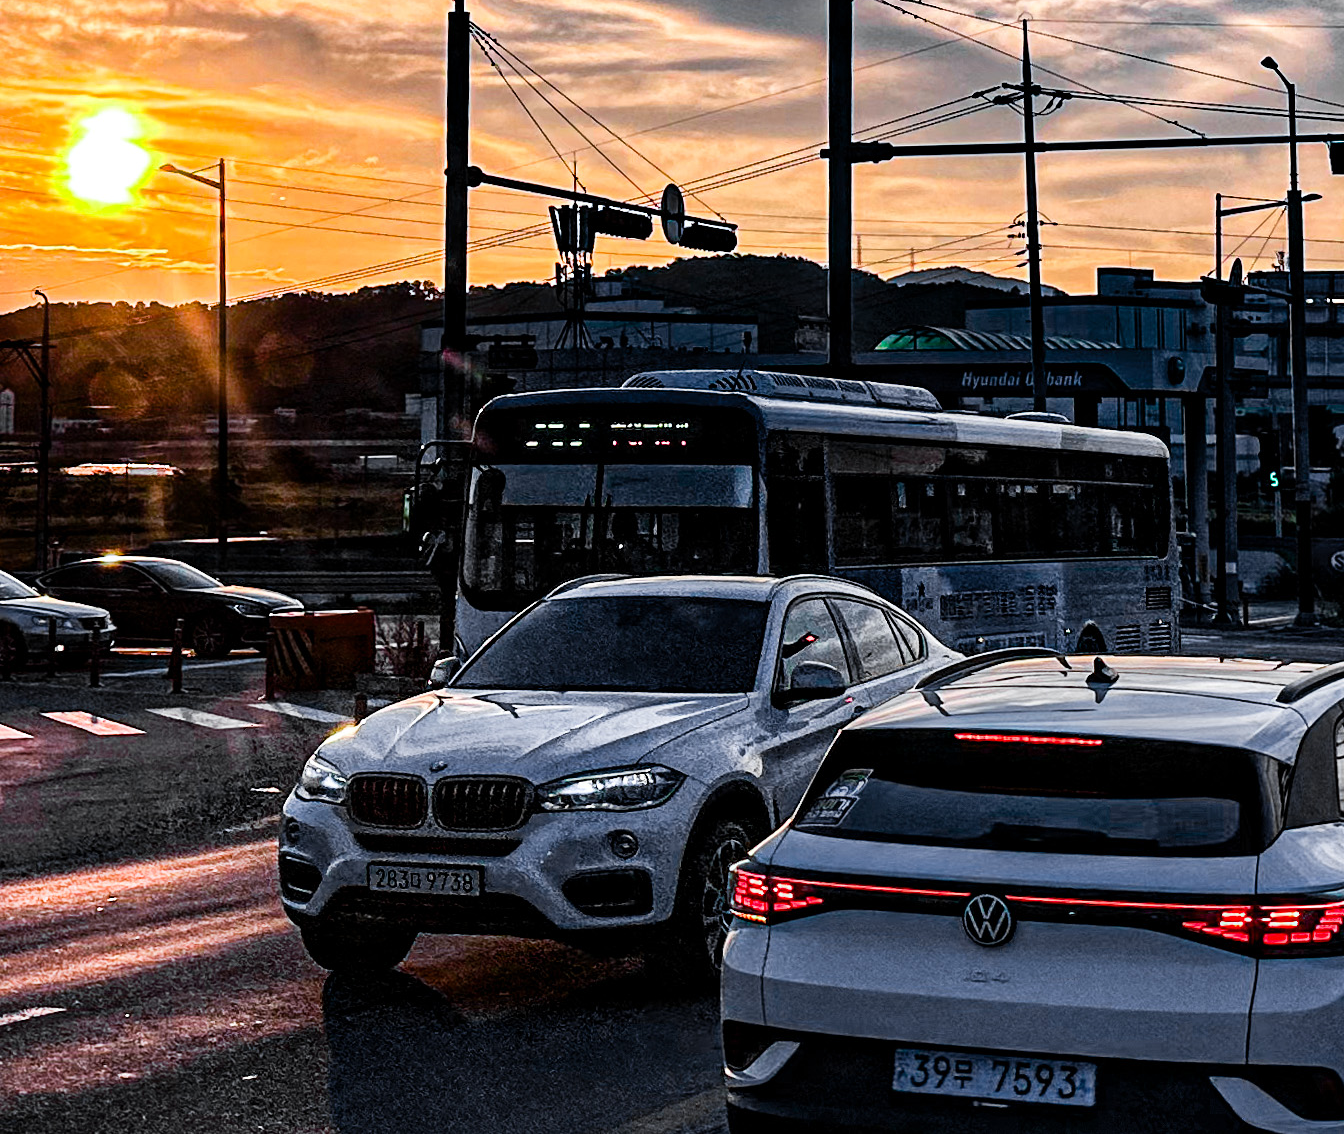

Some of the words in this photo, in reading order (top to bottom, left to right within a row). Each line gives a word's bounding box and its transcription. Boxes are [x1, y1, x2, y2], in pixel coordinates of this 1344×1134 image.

[961, 371, 1021, 390] Hyundai
[1025, 370, 1083, 386] Obank
[426, 871, 474, 893] 9738
[910, 1054, 973, 1089] 39무
[991, 1060, 1078, 1099] 7593
